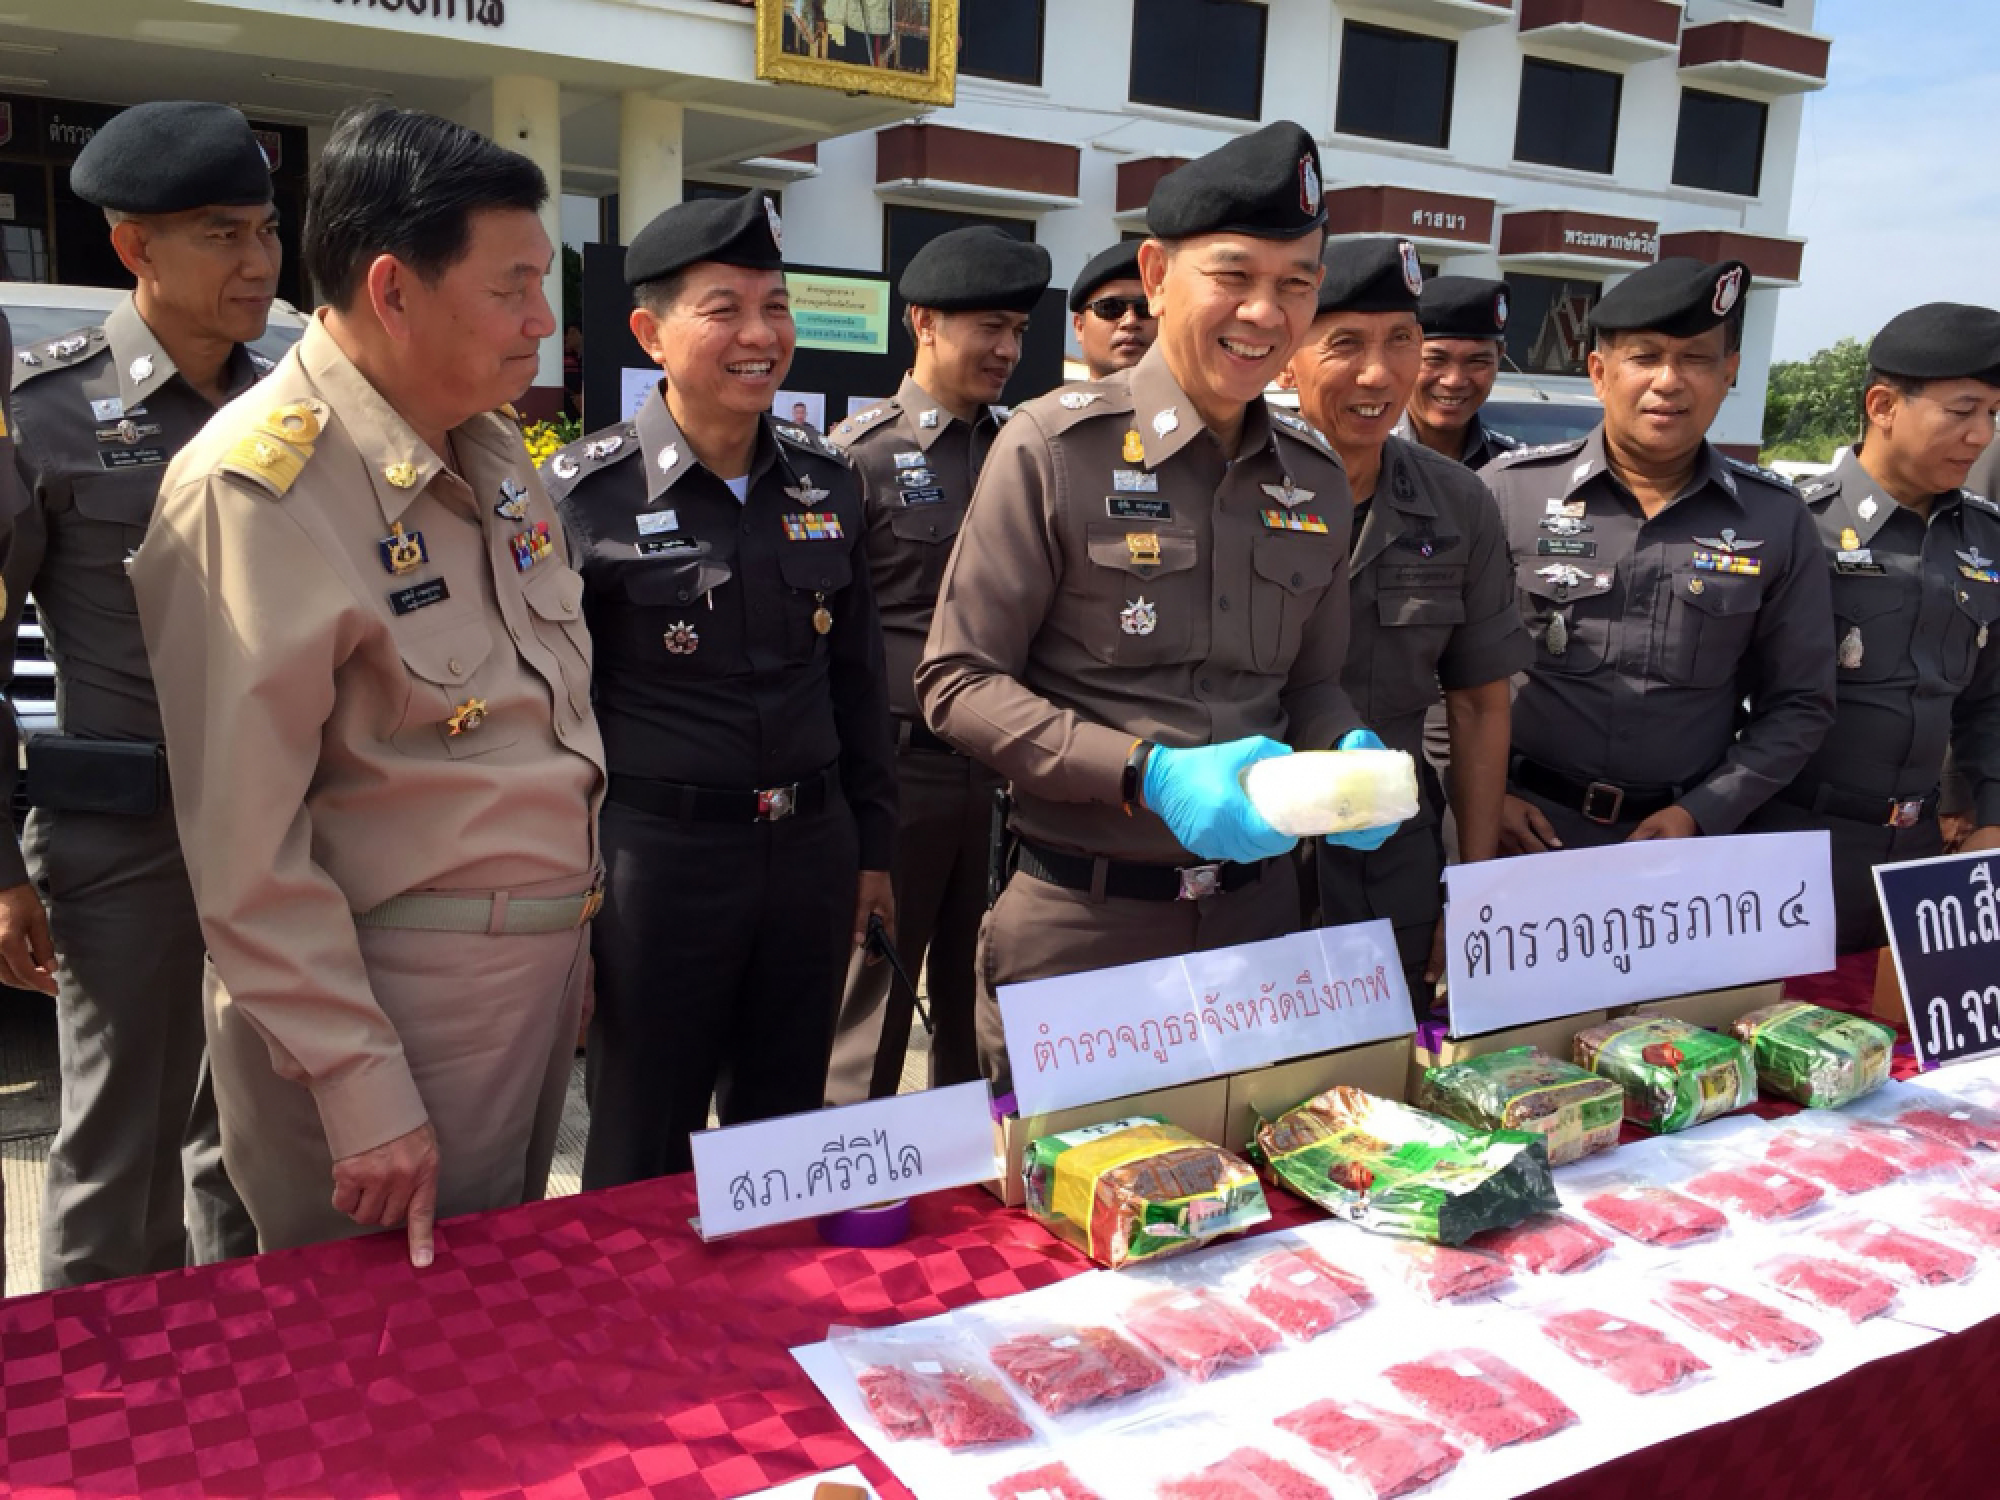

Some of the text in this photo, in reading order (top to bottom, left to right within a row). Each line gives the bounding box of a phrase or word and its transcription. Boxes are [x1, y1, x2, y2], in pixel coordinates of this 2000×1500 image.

[1464, 881, 1811, 978] ตำรวจภูธรภาค ๔
[1915, 862, 2000, 954] กก.สื
[1033, 966, 1391, 1072] ตำรวจภูธรจังหวัดบึงกาฬ
[730, 1128, 922, 1210] สภ.ศรีวิไล
